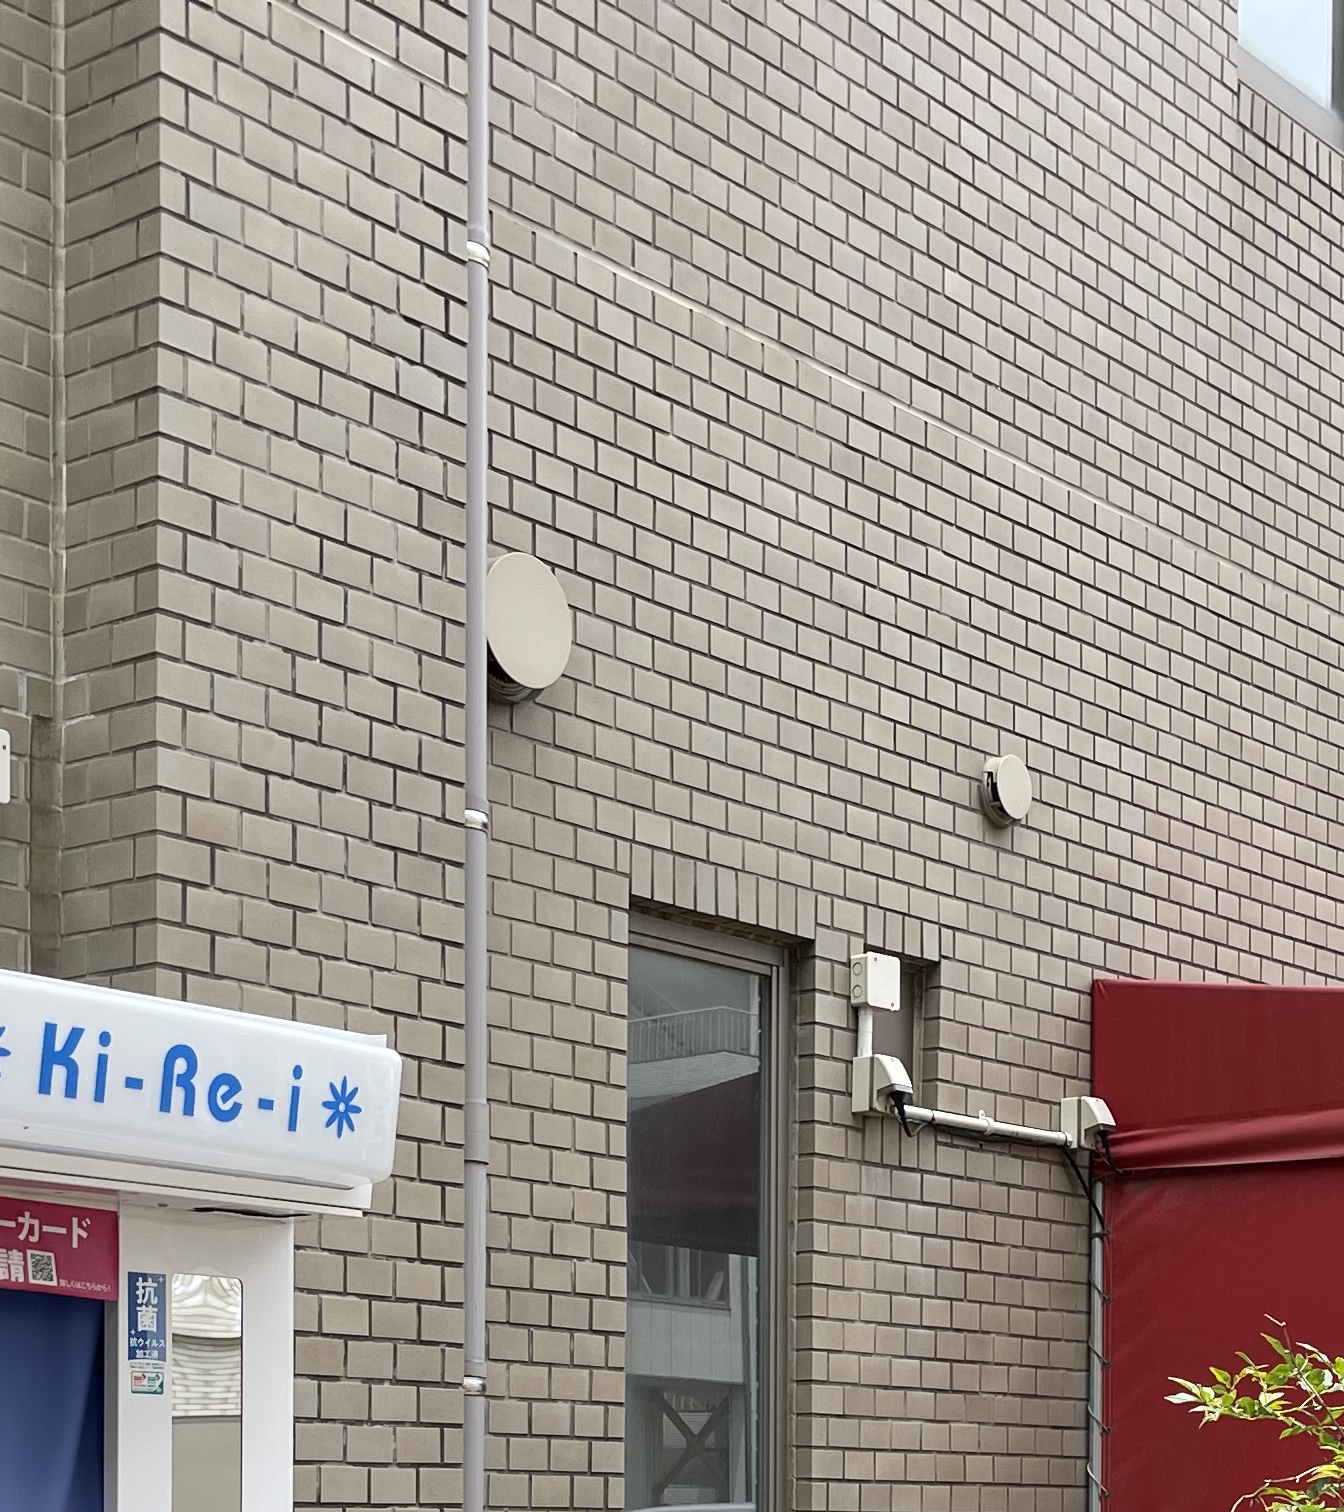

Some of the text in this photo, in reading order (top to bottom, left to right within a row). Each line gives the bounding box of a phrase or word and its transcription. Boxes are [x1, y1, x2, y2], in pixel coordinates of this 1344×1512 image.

[38, 1021, 304, 1133] Ki-Re-i
[136, 1277, 158, 1332] 抗菌
[129, 1337, 166, 1348] 抗ウイルス
